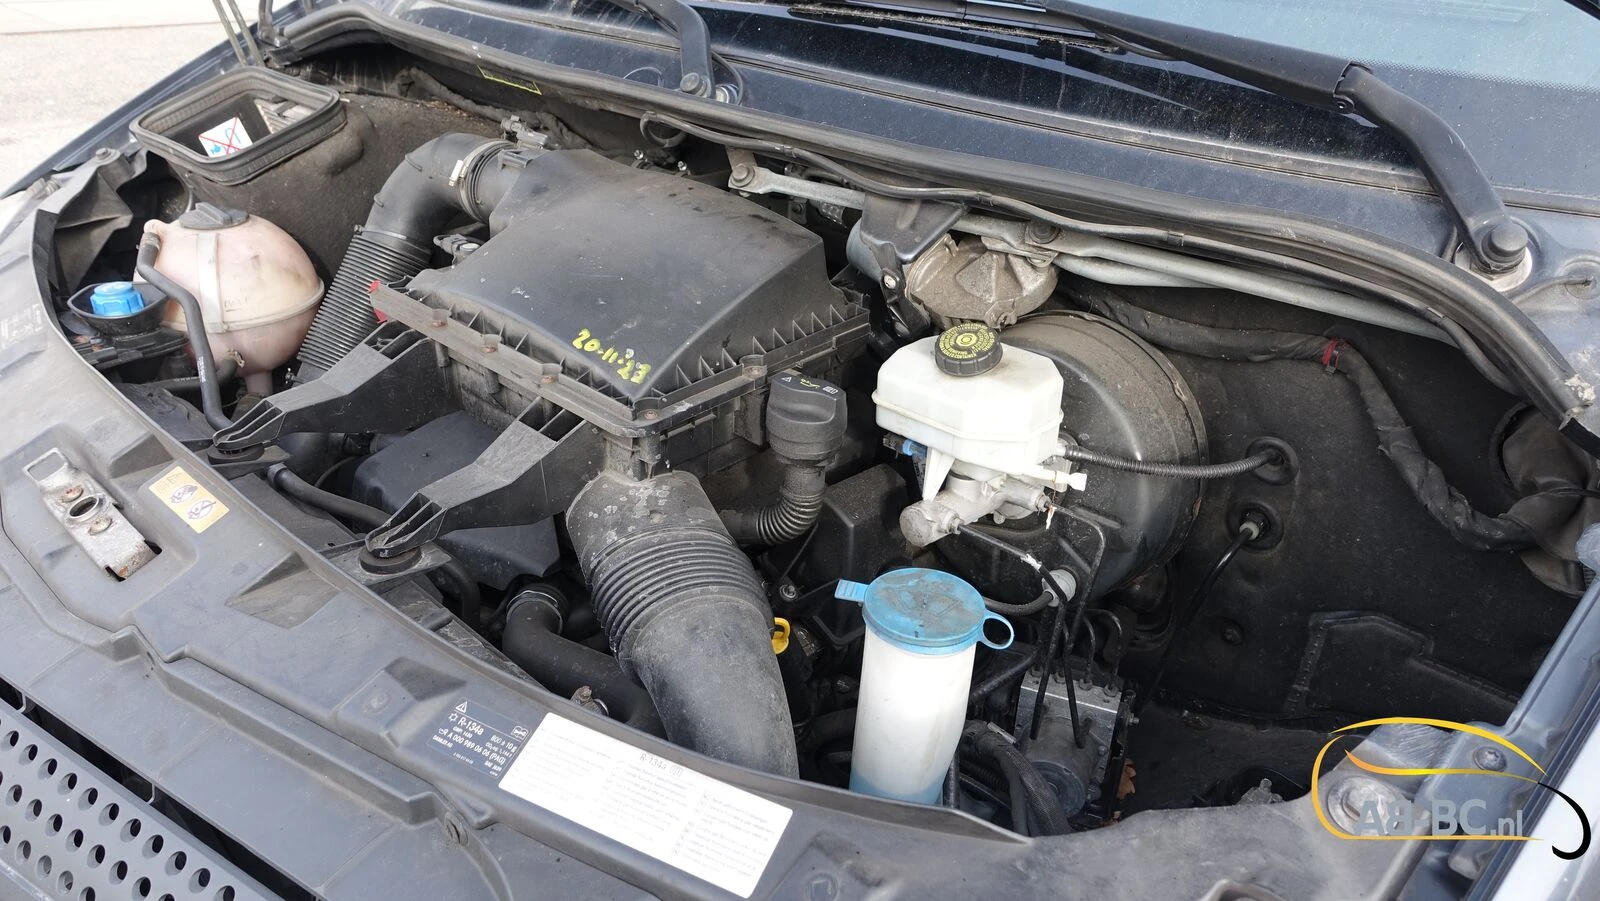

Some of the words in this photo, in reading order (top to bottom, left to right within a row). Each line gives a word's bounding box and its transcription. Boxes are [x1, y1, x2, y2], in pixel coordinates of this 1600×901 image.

[457, 716, 485, 736] R-134a
[446, 731, 453, 739] A
[452, 734, 464, 744] 000
[463, 739, 475, 749] 989
[473, 744, 482, 753] 06
[481, 748, 490, 757] 06
[489, 752, 507, 766] (PAG)
[490, 734, 503, 745] 800
